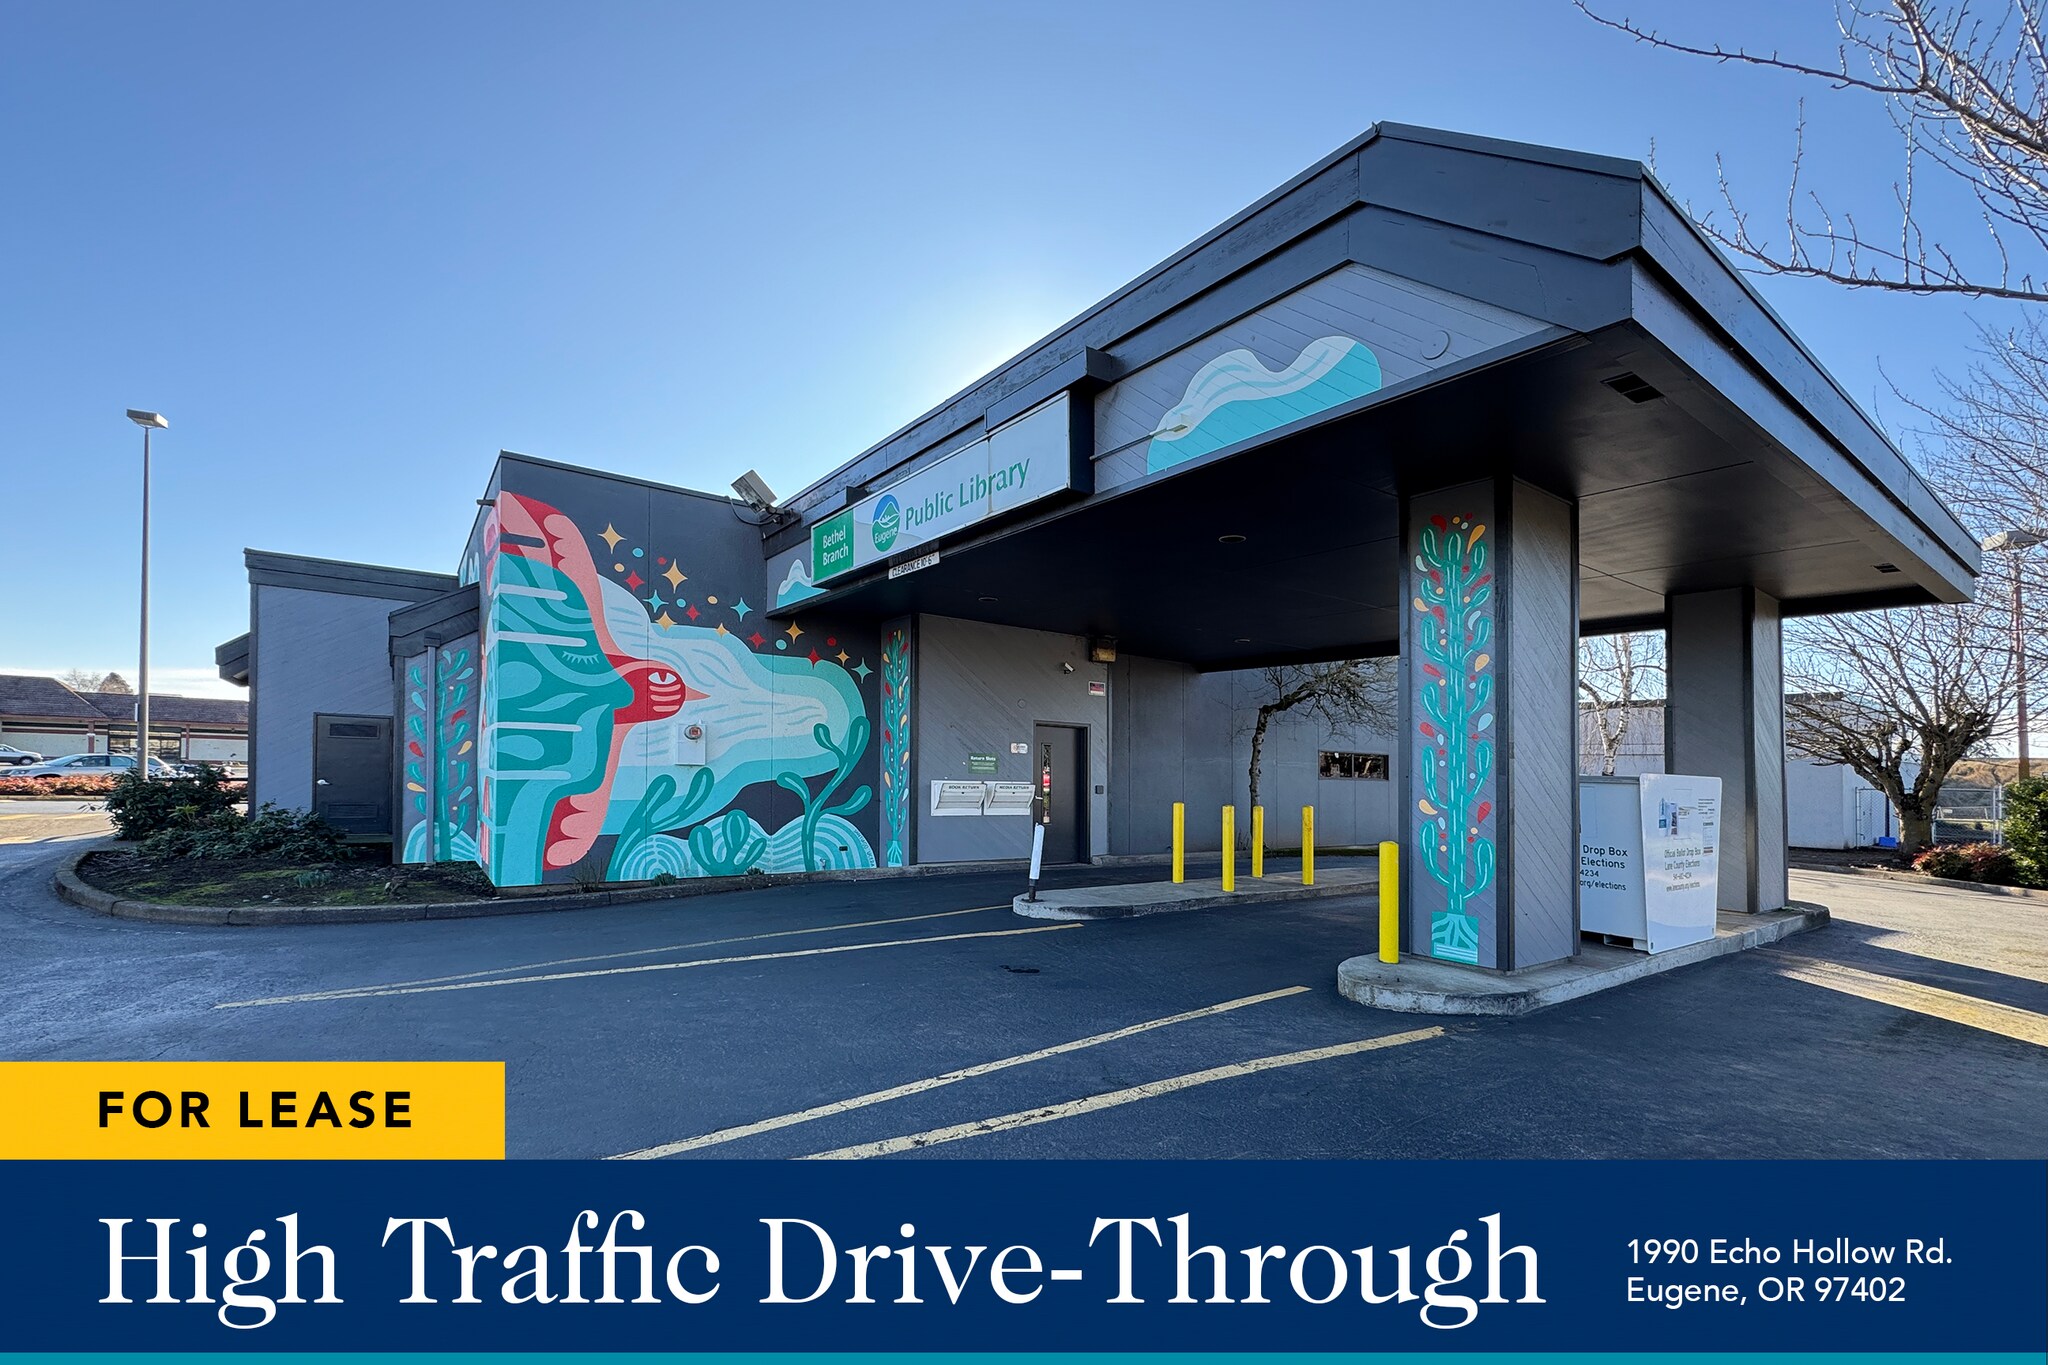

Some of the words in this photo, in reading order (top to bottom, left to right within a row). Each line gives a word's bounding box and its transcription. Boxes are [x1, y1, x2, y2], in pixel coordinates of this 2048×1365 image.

[906, 491, 954, 530] Public
[960, 458, 1030, 507] Library
[822, 525, 846, 549] Bethel
[874, 526, 898, 544] Eugene
[822, 543, 849, 566] Branch
[892, 559, 920, 577] CLEARANCE
[1582, 844, 1606, 857] Drop
[1608, 846, 1628, 856] Box
[1581, 856, 1626, 868] Elections
